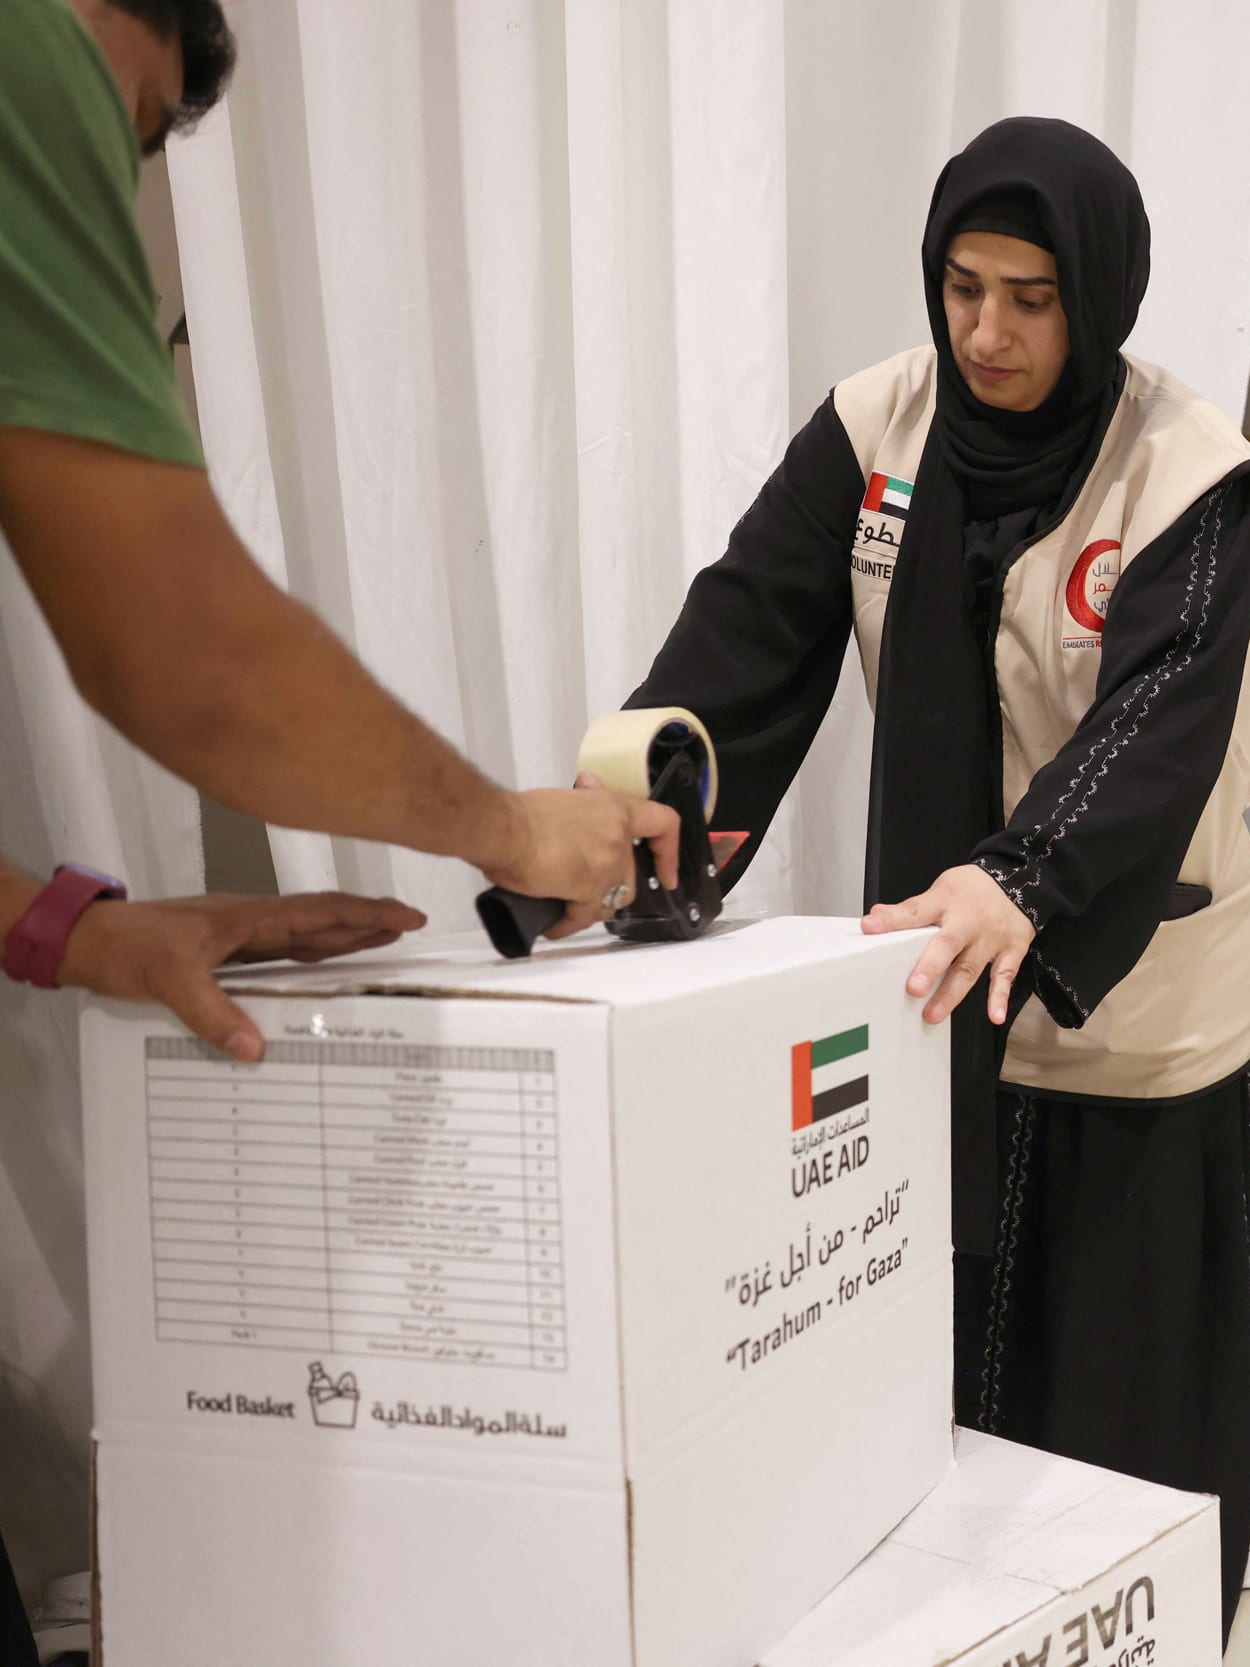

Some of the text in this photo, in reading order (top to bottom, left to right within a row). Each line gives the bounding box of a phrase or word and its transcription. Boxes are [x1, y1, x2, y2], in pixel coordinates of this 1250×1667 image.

[851, 554, 893, 580] OLUNTE
[1062, 640, 1095, 649] EMIRATES
[791, 1134, 870, 1198] UAE AID
[838, 1272, 862, 1307] for
[187, 1391, 295, 1419] Food Basket
[1062, 1576, 1155, 1667] UAE
